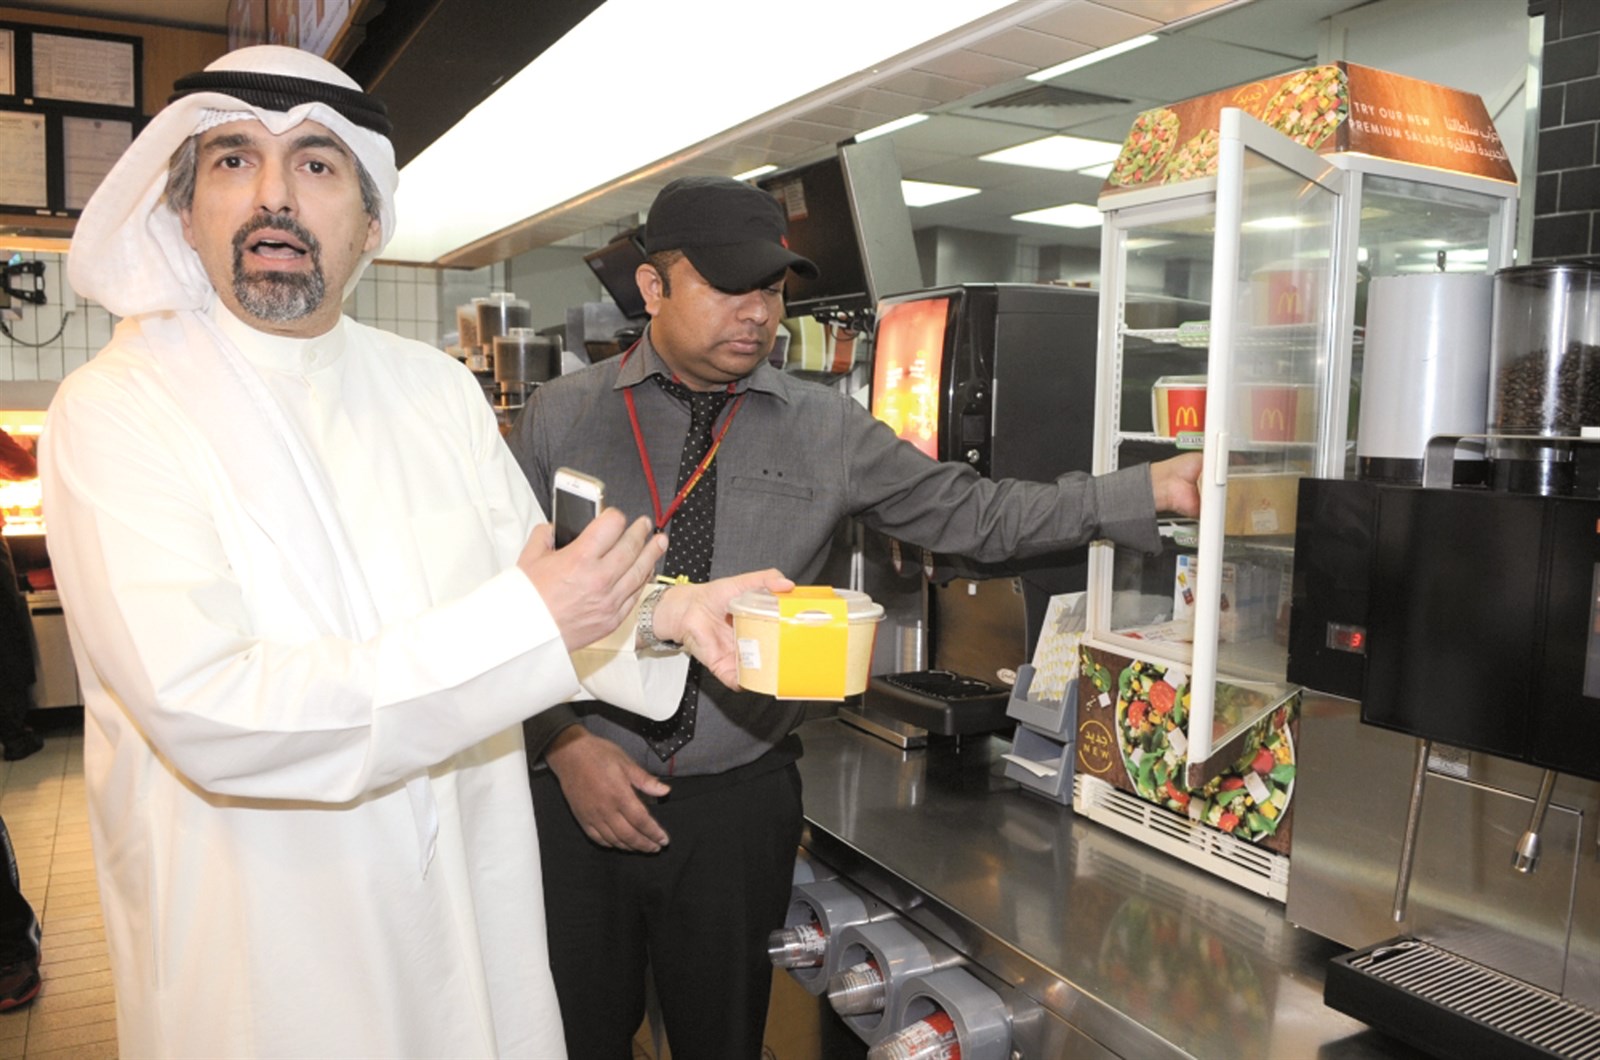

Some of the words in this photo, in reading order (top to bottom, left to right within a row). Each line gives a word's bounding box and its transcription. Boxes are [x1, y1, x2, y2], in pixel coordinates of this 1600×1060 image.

[1354, 102, 1375, 115] TRY
[1379, 107, 1403, 122] OUR
[1407, 114, 1430, 126] NEW
[1348, 118, 1402, 139] PREMIUM
[1405, 130, 1445, 148] SALADS
[1084, 730, 1108, 747] جديد
[1083, 743, 1109, 760] NEW
